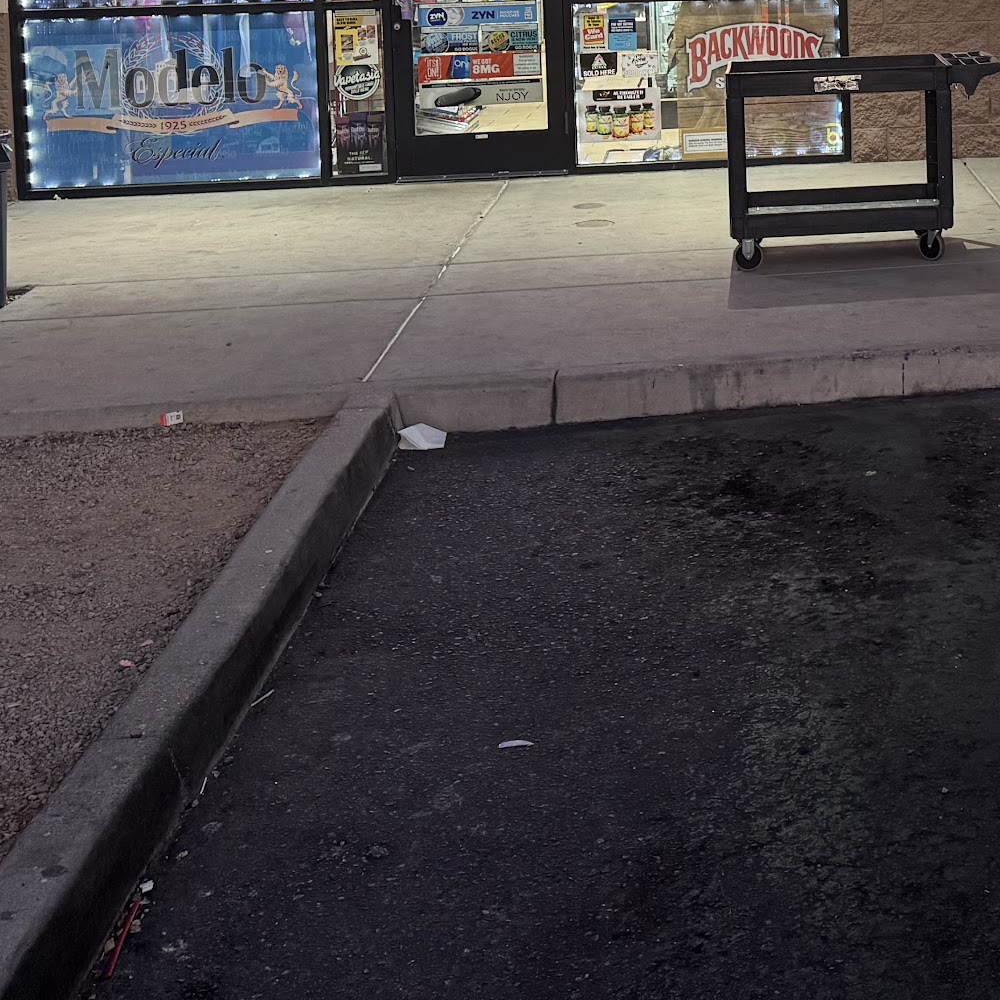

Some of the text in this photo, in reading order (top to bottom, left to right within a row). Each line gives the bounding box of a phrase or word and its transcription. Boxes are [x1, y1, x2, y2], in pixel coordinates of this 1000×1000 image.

[429, 12, 446, 21] ZYN
[471, 10, 495, 19] ZYN
[451, 32, 478, 41] FROST
[510, 30, 538, 38] CITRUS
[584, 33, 603, 41] Card
[689, 25, 820, 83] BACKWOODS
[473, 64, 500, 75] 8MG
[74, 46, 267, 110] Modelo
[334, 69, 381, 87] Vapetasia
[496, 92, 529, 102] NJOY
[160, 120, 187, 131] 1925
[124, 138, 223, 168] Especial
